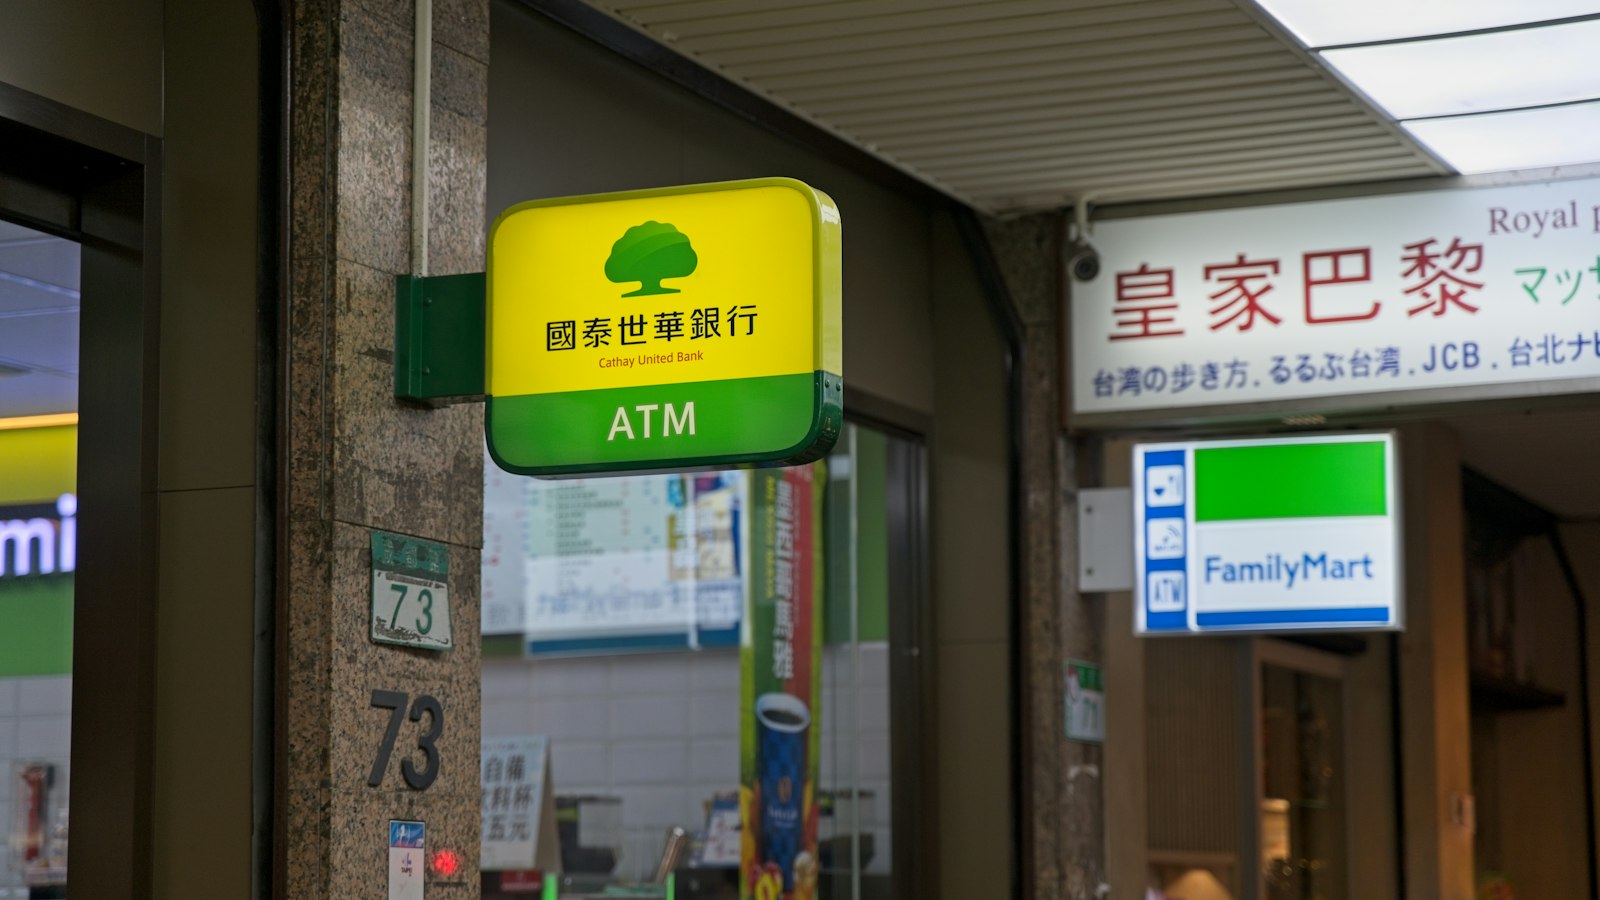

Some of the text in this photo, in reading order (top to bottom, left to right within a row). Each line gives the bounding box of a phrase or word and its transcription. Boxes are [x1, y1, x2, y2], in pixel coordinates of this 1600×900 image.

[1488, 200, 1578, 238] Royal
[1107, 235, 1486, 342] 皇家巴黎
[546, 305, 758, 352] 國泰世華銀行
[599, 350, 703, 368] Cathay United Bank
[607, 401, 696, 441] ATM
[1205, 553, 1374, 589] FamilyMart
[390, 584, 433, 635] 73
[367, 689, 443, 790] 73
